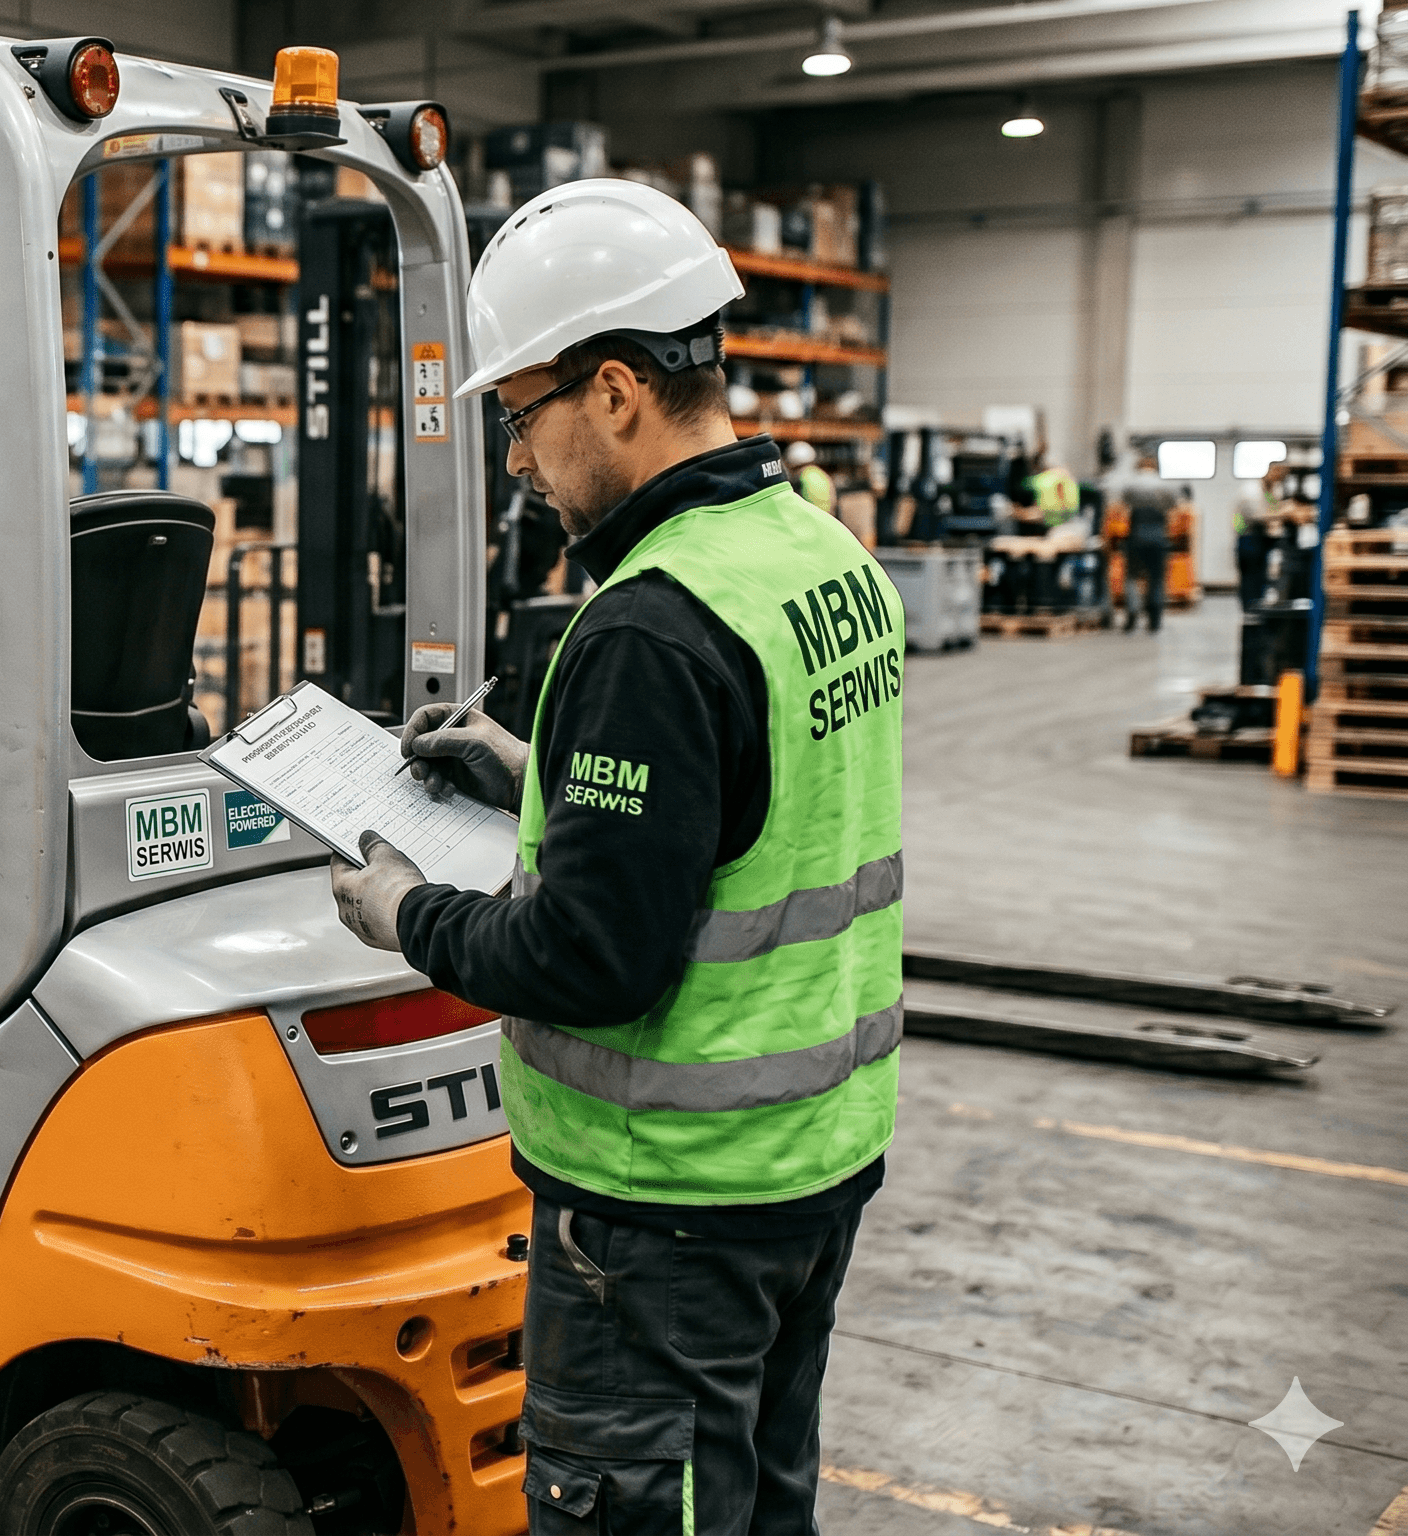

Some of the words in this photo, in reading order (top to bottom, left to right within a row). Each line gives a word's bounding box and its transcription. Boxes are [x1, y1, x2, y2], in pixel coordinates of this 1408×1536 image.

[306, 294, 330, 440] STILL
[780, 563, 893, 677] MBM
[809, 647, 901, 741] SERWIS
[570, 751, 650, 793] MBM
[564, 784, 644, 815] SERWIS
[135, 802, 203, 842] MBM
[229, 814, 276, 833] POWERED
[136, 837, 205, 867] SERWIS
[369, 1061, 502, 1140] STI
